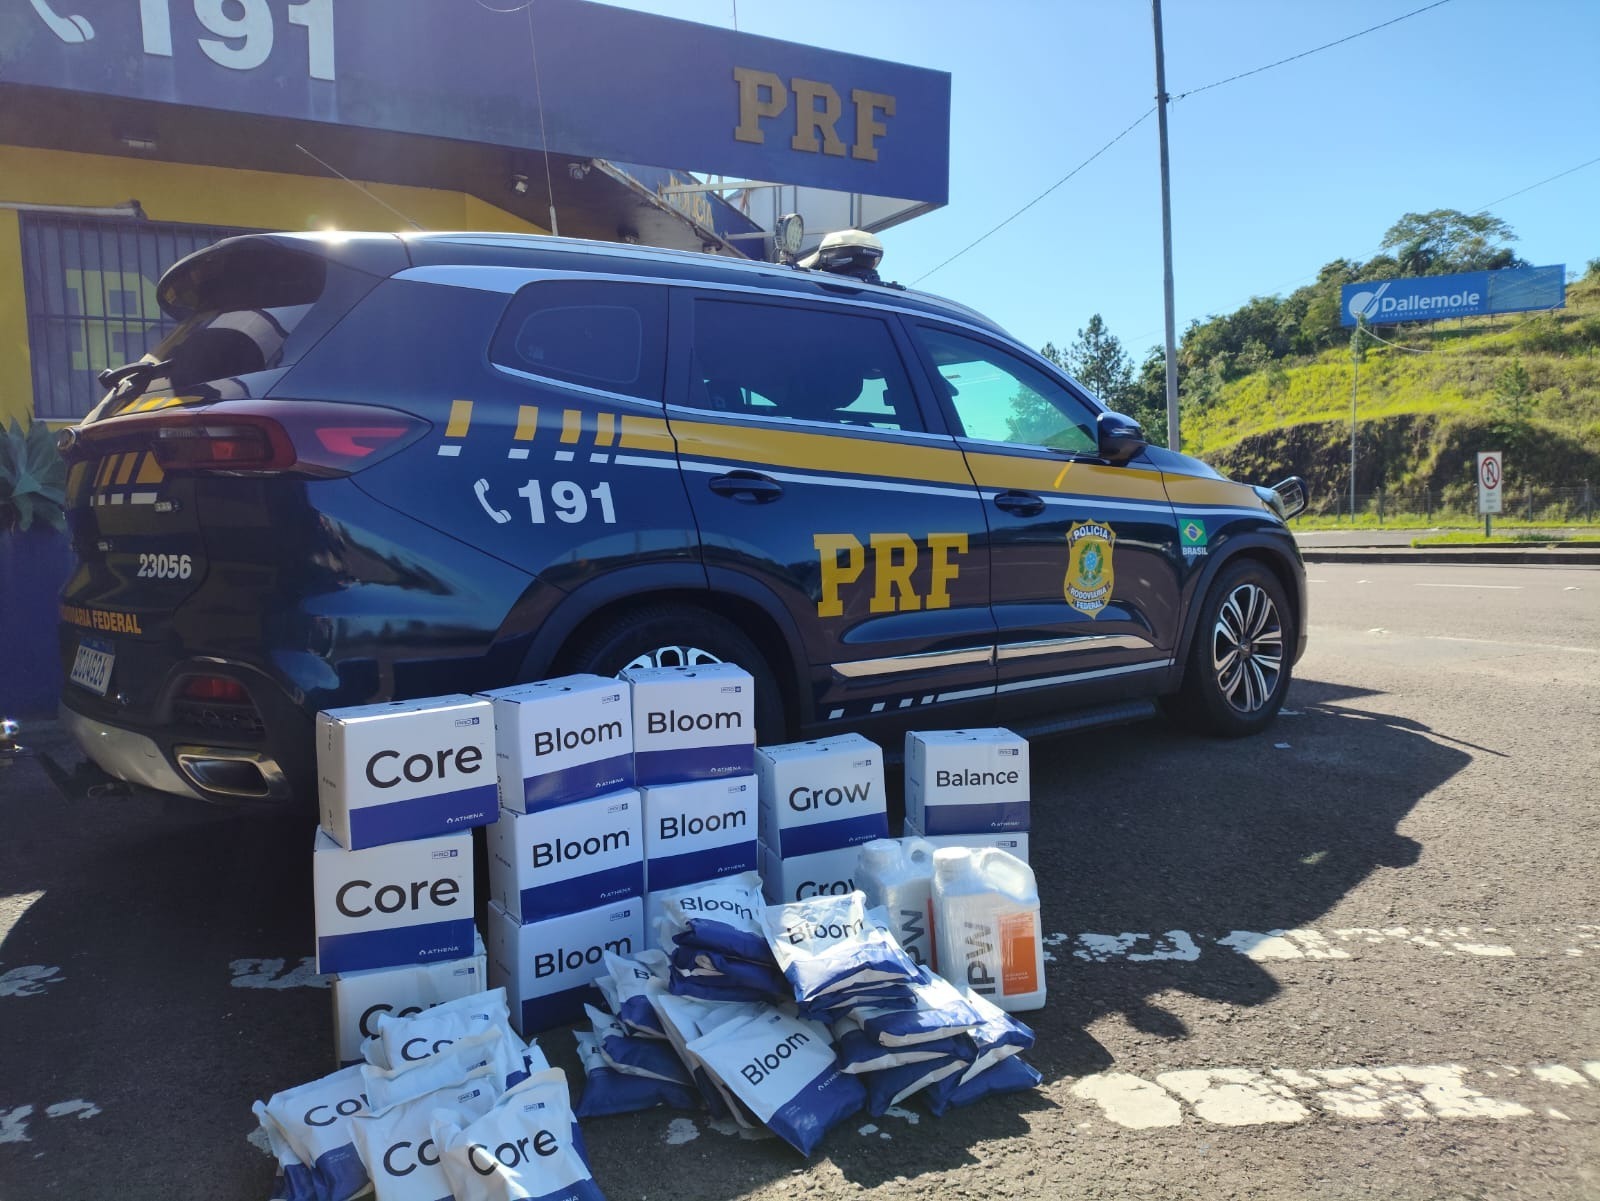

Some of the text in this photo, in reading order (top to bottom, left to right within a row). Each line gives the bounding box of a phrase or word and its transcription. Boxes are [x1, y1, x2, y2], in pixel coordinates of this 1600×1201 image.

[141, 0, 336, 81] 191
[733, 66, 896, 162] PRF
[1381, 290, 1480, 313] Dallemole
[518, 479, 616, 524] 191
[137, 553, 192, 580] 23056
[1182, 547, 1209, 556] BRASIL
[813, 533, 969, 618] PRF
[92, 609, 142, 635] FEDERAL
[1076, 600, 1103, 610] FEDERAL
[534, 720, 623, 757] Bloom
[647, 709, 742, 734] Bloom
[366, 746, 483, 789] Core
[936, 768, 1019, 788] Balance
[789, 781, 871, 812] Grow
[455, 812, 484, 823] ATHENA
[659, 810, 746, 840] Bloom
[532, 829, 630, 869] Bloom
[335, 878, 460, 918] Core
[796, 878, 855, 902] Gro
[680, 896, 752, 922] Bloom
[428, 945, 460, 956] ATHENA
[900, 909, 927, 965] PW
[534, 936, 632, 979] Bloom
[964, 921, 996, 995] IPW
[740, 1030, 811, 1087] Bloom
[467, 1129, 560, 1176] Core
